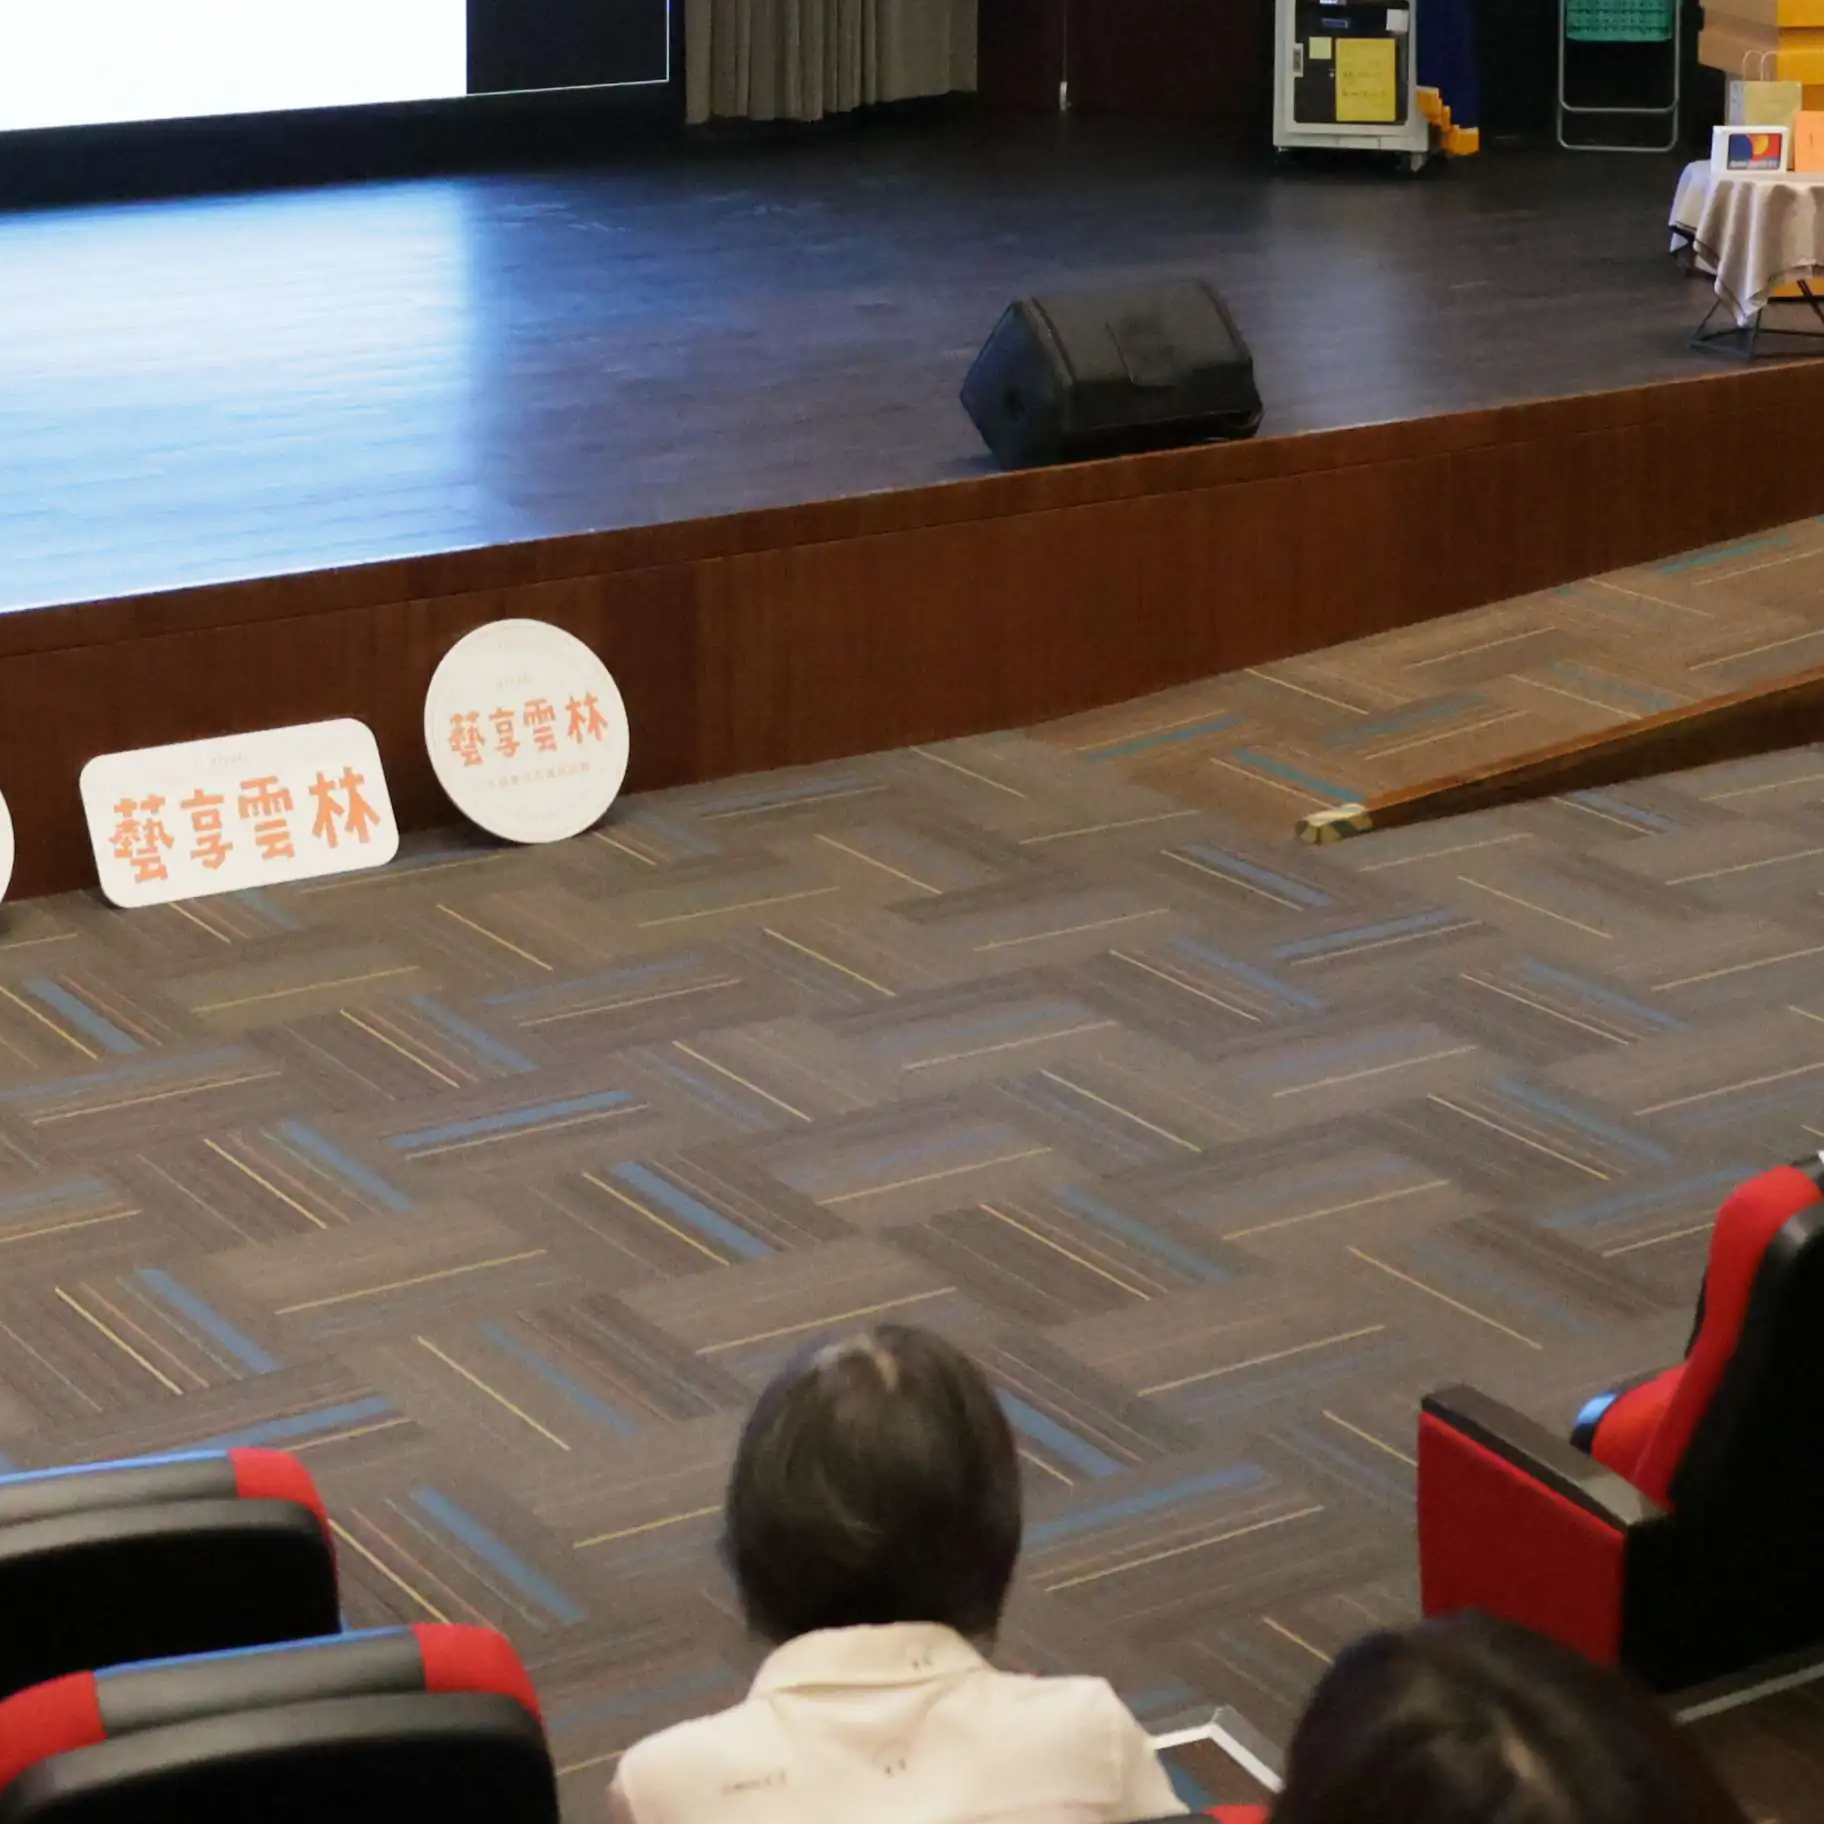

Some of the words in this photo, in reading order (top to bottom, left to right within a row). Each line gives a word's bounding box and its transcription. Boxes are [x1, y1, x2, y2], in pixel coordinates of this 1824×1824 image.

[447, 692, 610, 767] 藝享雲林
[108, 766, 381, 883] 藝享雲林
